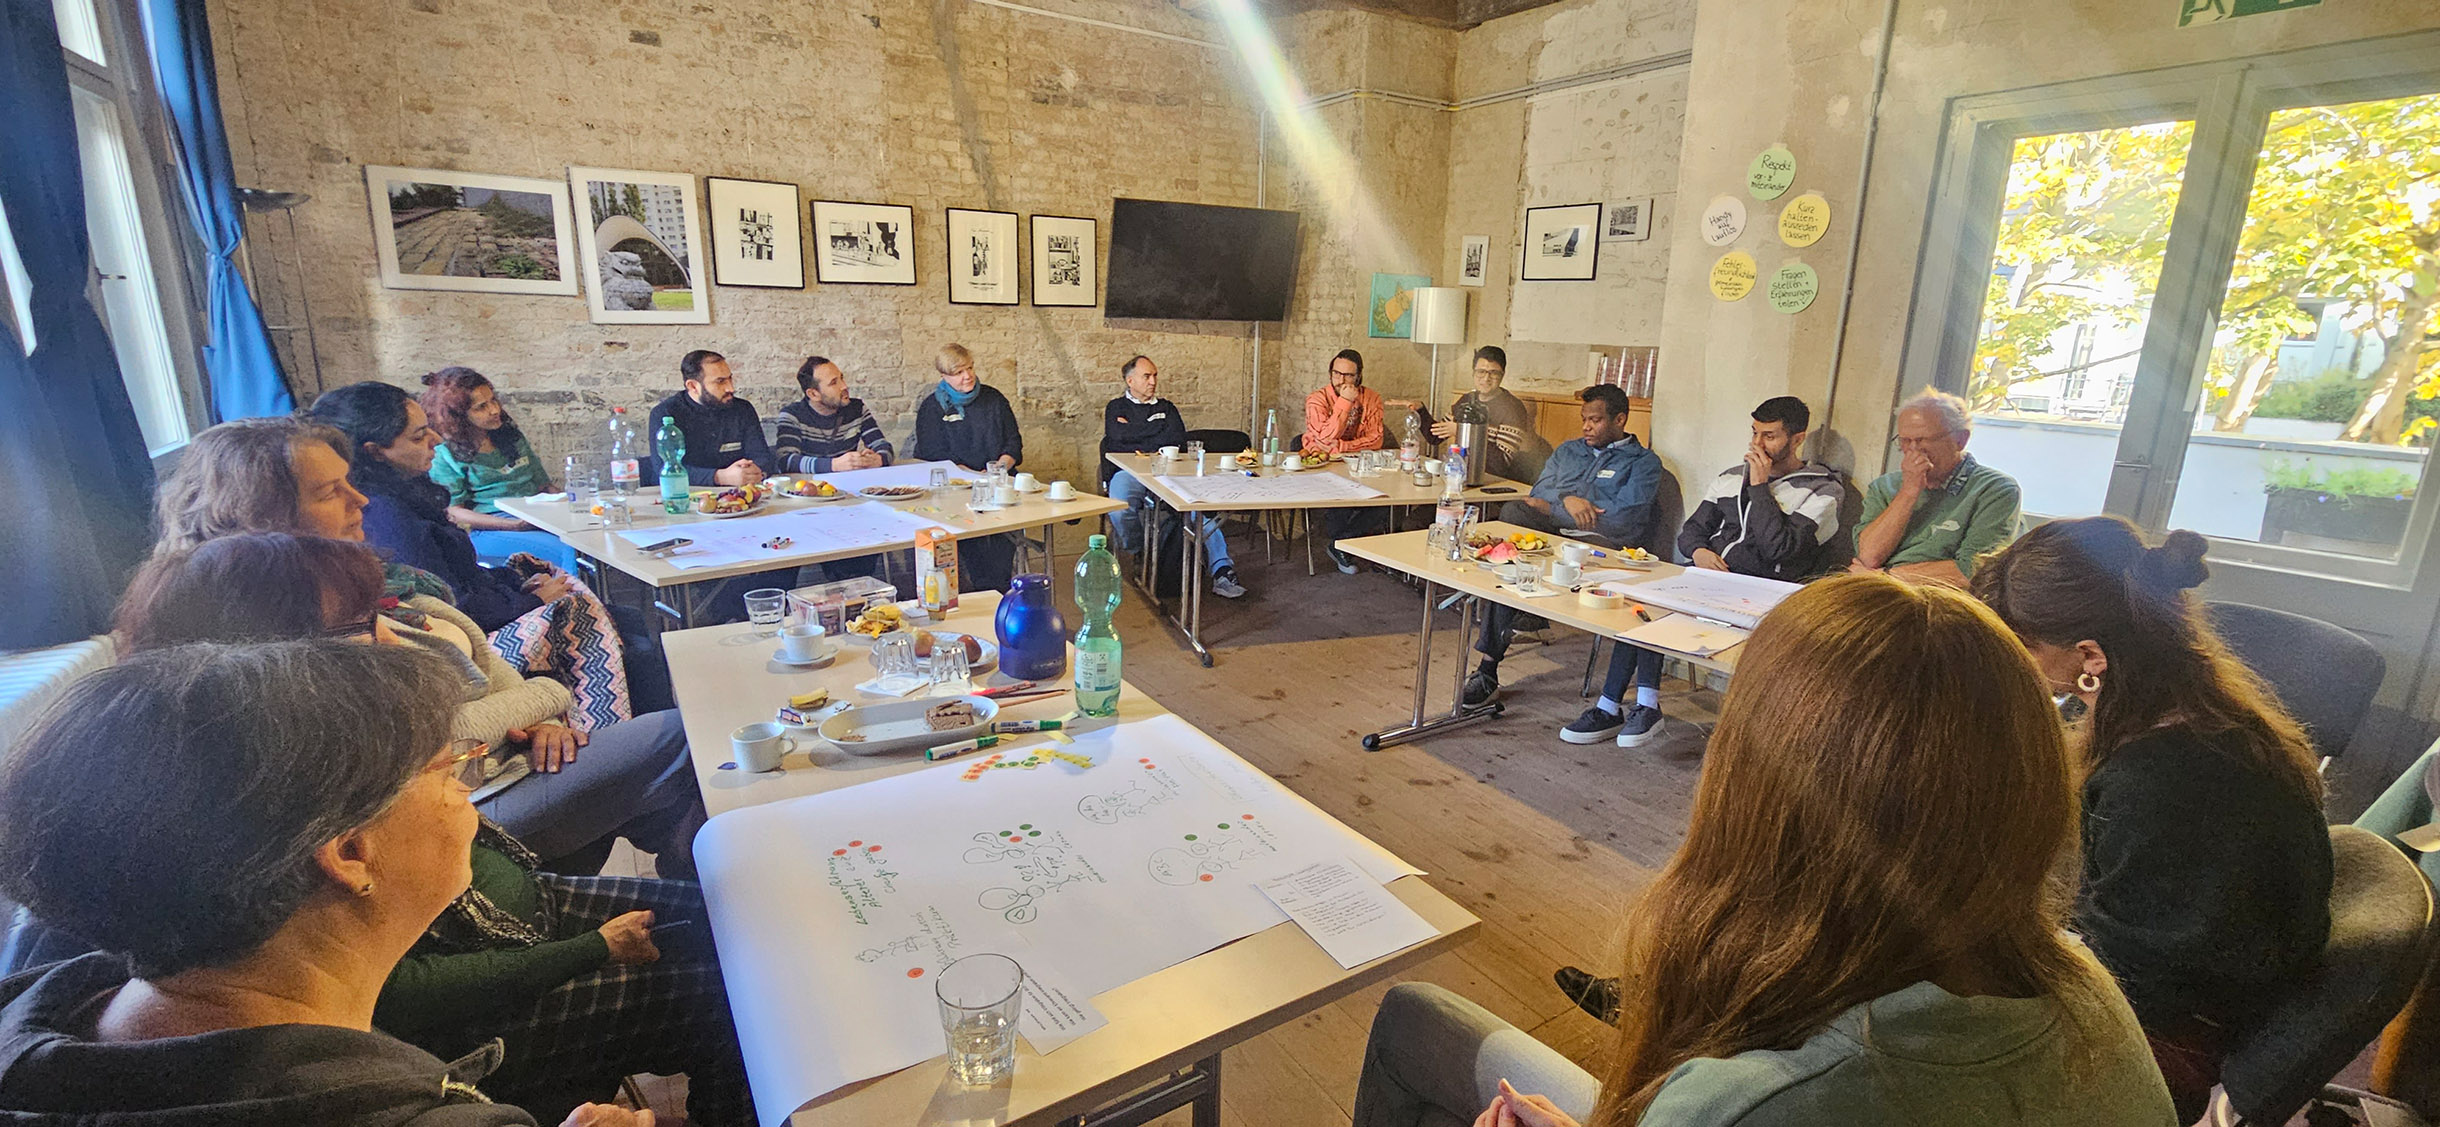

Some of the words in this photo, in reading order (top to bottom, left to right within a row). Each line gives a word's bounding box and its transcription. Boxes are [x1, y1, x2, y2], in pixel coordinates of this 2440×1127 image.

[1761, 154, 1792, 176] Respekt
[1797, 200, 1816, 214] Kurz
[1708, 211, 1733, 226] Handy
[1781, 269, 1807, 281] Fragen
